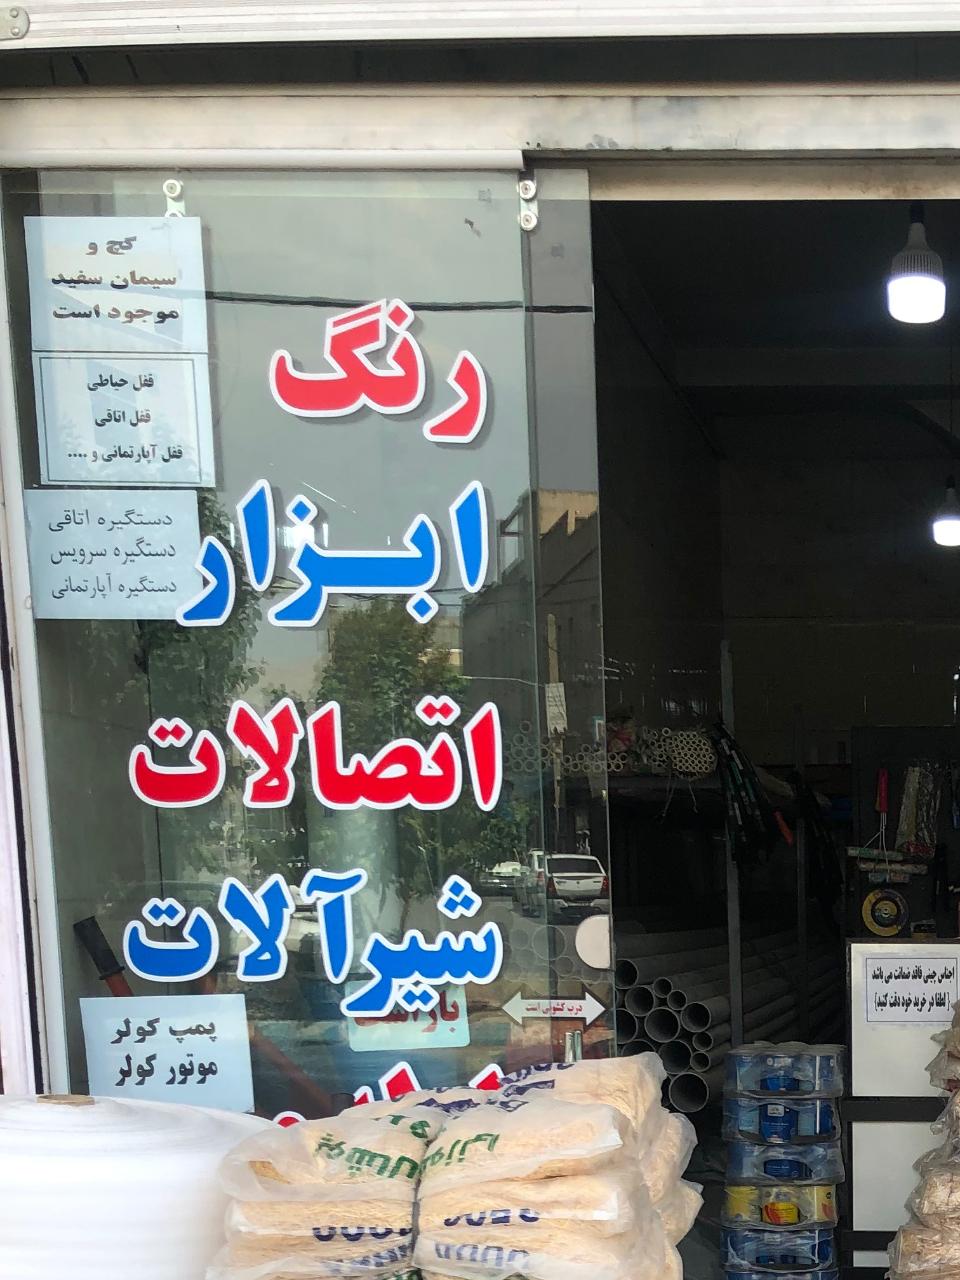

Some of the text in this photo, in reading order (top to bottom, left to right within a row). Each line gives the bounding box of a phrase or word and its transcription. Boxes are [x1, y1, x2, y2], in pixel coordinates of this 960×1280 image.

[86, 241, 98, 256] و
[51, 269, 177, 289] سیمان سفید
[52, 303, 179, 323] موجود است
[268, 297, 488, 444] رنگ
[87, 373, 154, 391] قفل حیاطی
[95, 408, 152, 427] قفل اتاقی
[91, 450, 98, 462] و
[101, 444, 157, 464] آپارتمانی
[161, 445, 183, 462] قفل
[49, 508, 173, 532] دستگیره اتاقی
[50, 536, 177, 565] دستگیره سرویس
[174, 479, 488, 627] ابزار
[51, 572, 177, 600] دستگیره آپارتمانی
[128, 695, 504, 812] اتصالات
[123, 868, 504, 1018] شیرآلات
[871, 964, 955, 985] اجناس چینی فاقد ضمانت می باشد
[110, 1017, 218, 1044] پمپ کولر
[115, 1053, 218, 1086] موتور کولر
